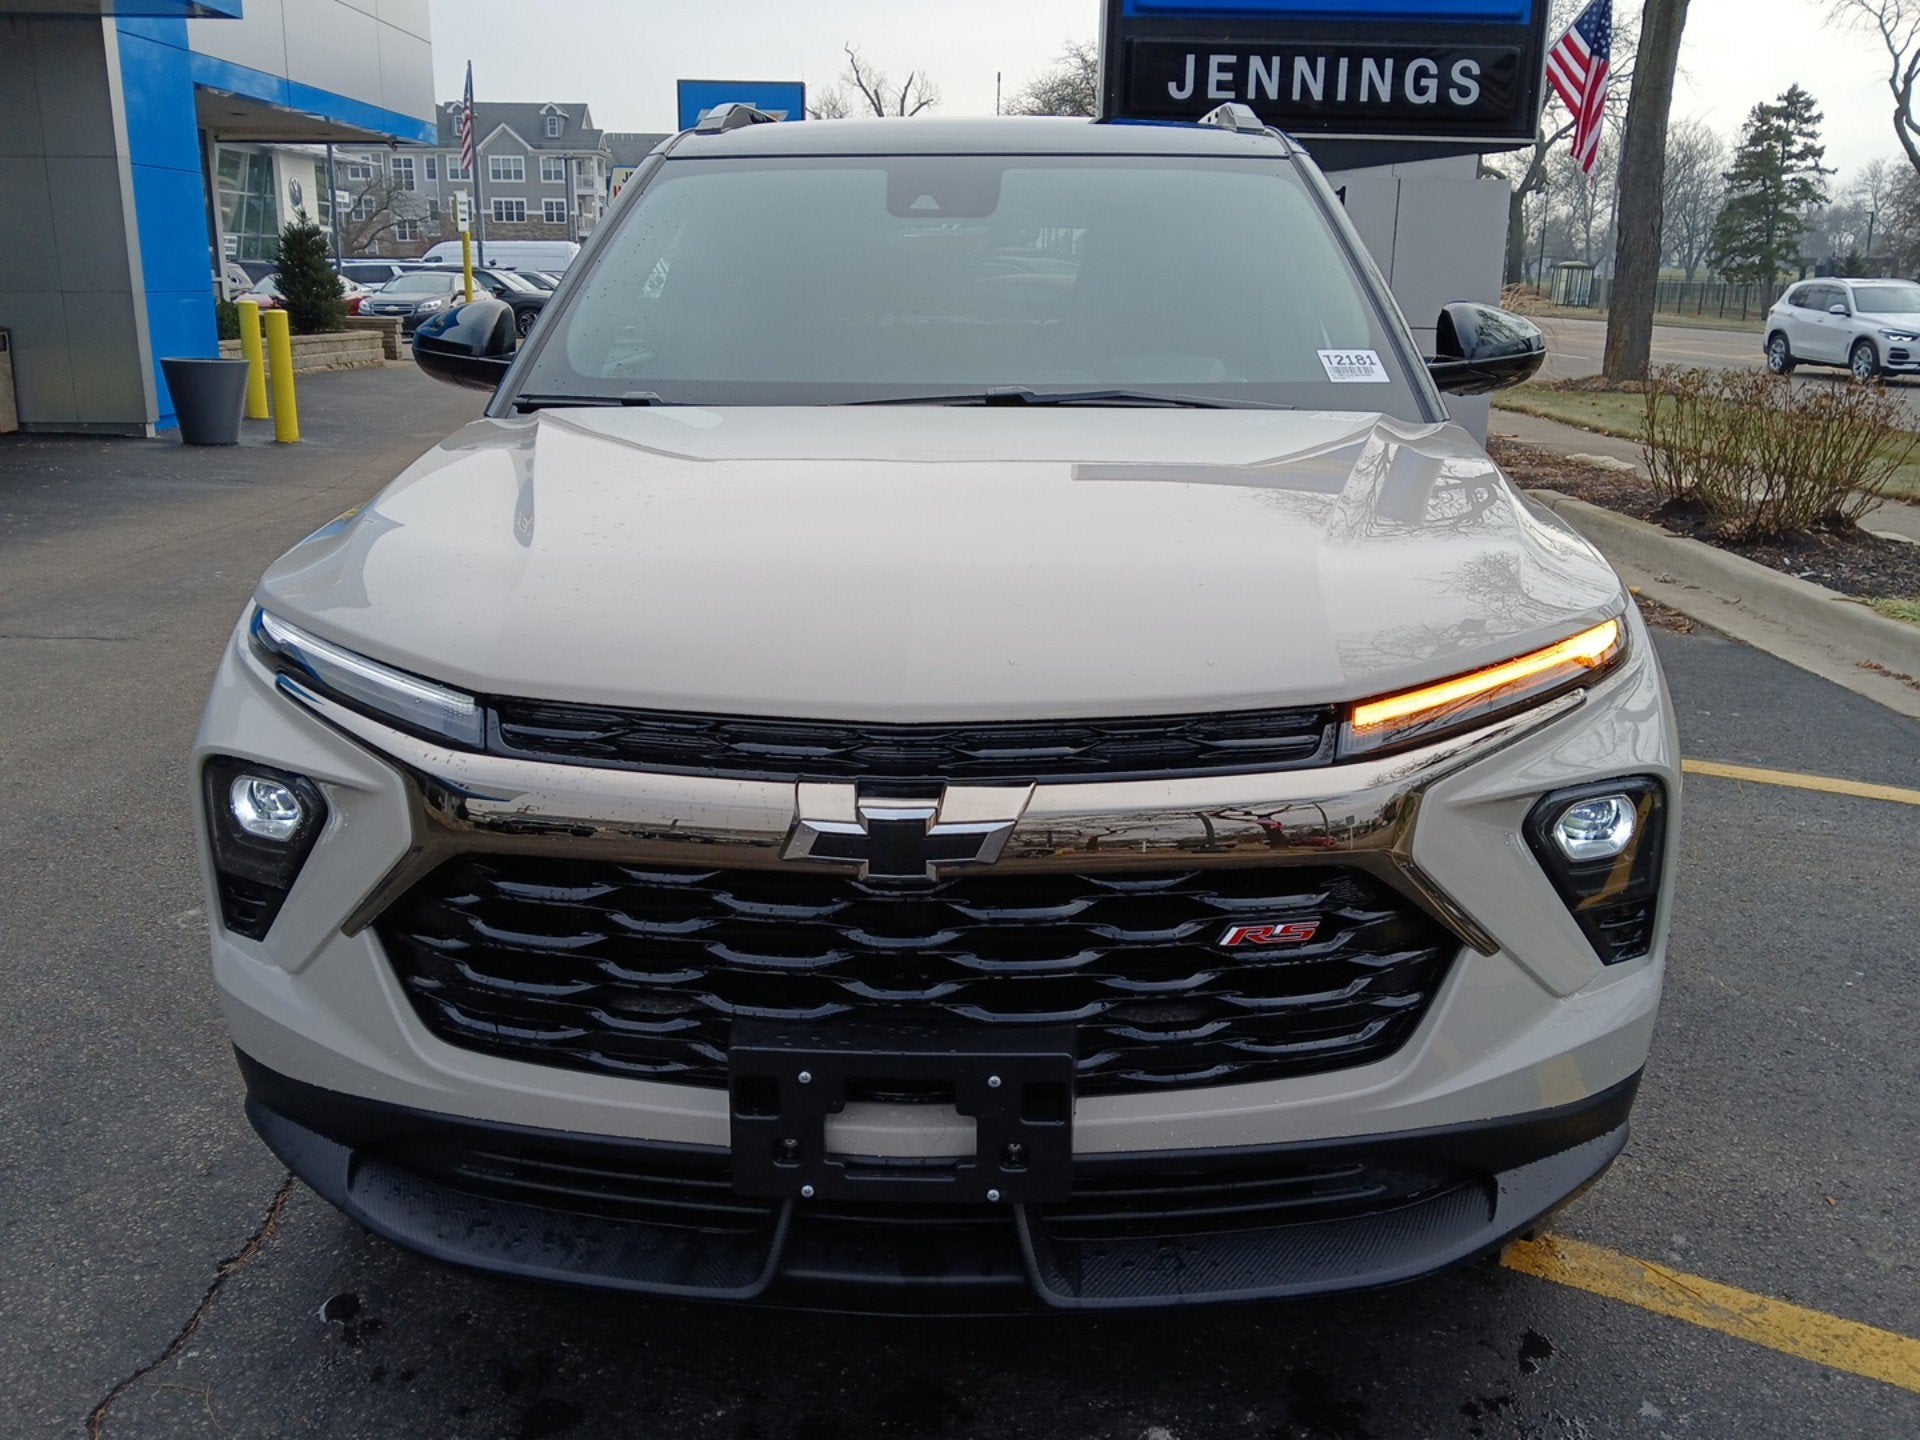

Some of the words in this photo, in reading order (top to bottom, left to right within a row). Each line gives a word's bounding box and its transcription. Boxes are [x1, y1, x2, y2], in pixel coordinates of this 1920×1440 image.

[1168, 54, 1481, 105] JENNINGS
[1323, 354, 1377, 366] T2181
[1219, 921, 1320, 947] RS
